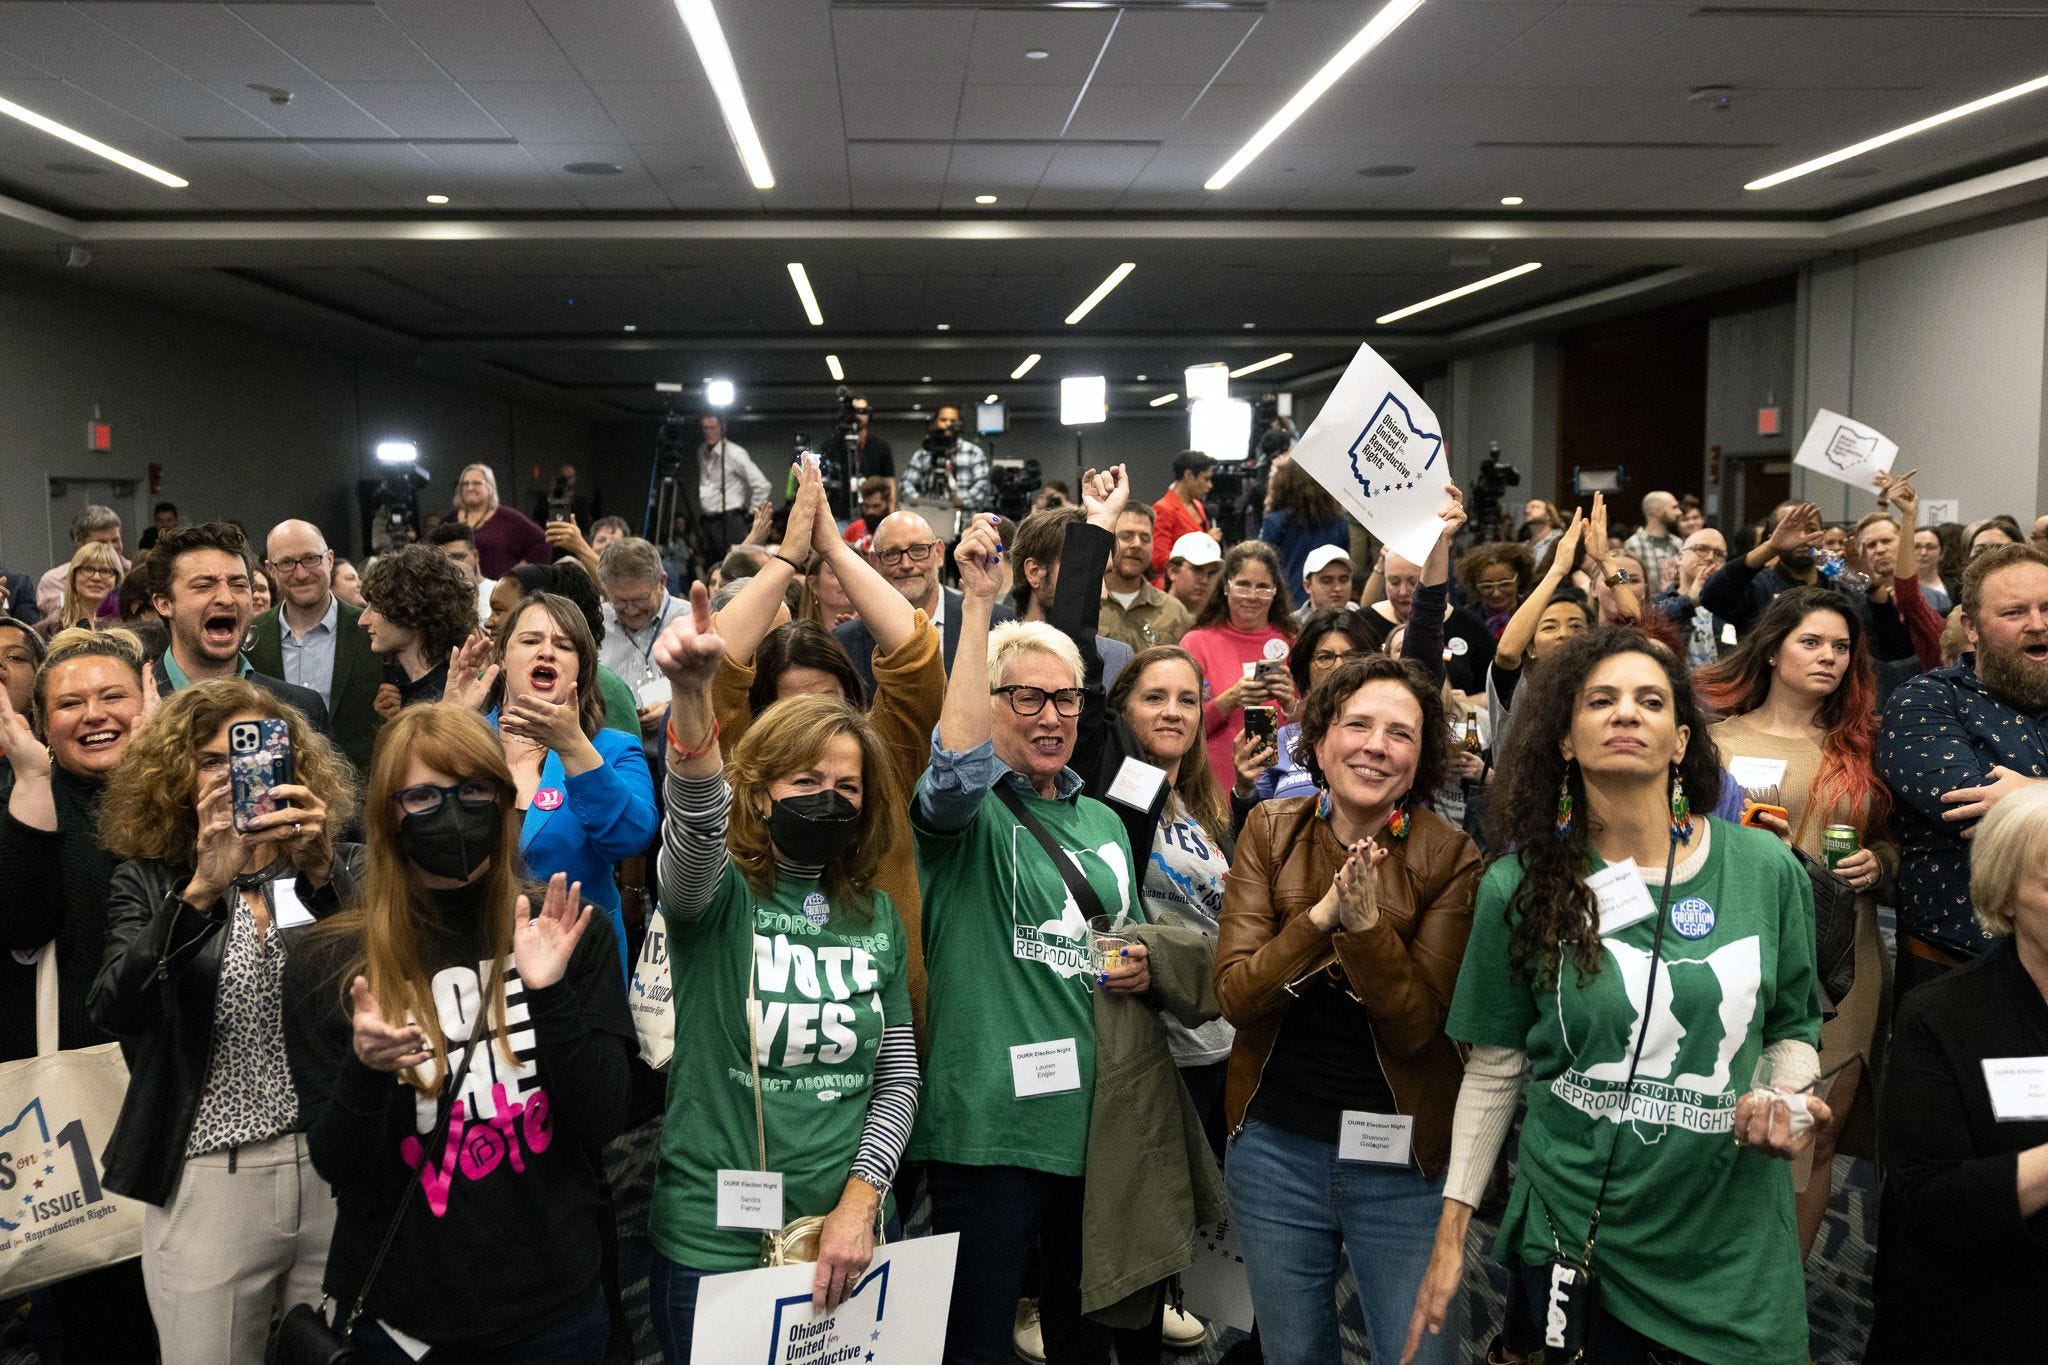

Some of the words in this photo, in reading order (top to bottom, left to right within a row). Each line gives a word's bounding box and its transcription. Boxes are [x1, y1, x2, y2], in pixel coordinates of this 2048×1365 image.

[1375, 424, 1399, 450] United
[1382, 414, 1409, 444] Ohioans
[1361, 444, 1385, 470] Rights
[1368, 434, 1411, 479] Reproductive
[1158, 815, 1210, 861] YES
[1615, 871, 1632, 881] Night
[1142, 887, 1165, 900] hioans
[1680, 899, 1706, 912] KEEP
[1674, 911, 1714, 924] ABORTION
[1677, 921, 1709, 936] LEGAL
[643, 930, 667, 965] YE
[755, 933, 878, 1001] VOTE
[402, 952, 532, 1044] OE
[746, 998, 858, 1068] YES
[1034, 1050, 1056, 1058] Election
[1056, 1046, 1071, 1054] Night
[728, 1066, 792, 1093] PROECT
[794, 1073, 864, 1096] ABORTION
[1035, 1063, 1056, 1071] Lauren
[1552, 1078, 1677, 1123] REPRODUCTIVE
[1562, 1071, 1591, 1088] HIO
[1604, 1080, 1703, 1107] PHYSICIANS
[1347, 1119, 1366, 1127] OURR
[1390, 1123, 1406, 1131] Night
[1361, 1133, 1390, 1141] Shannon
[400, 1082, 552, 1217] Vote
[1359, 1140, 1391, 1150] Gallagher
[16, 1152, 39, 1170] on
[56, 1118, 104, 1205] 1
[723, 1180, 741, 1188] OURR
[740, 1181, 762, 1189] Election
[762, 1183, 778, 1191] Night
[740, 1195, 761, 1204] Sandra
[31, 1189, 86, 1224] ISSUE
[24, 1212, 86, 1244] Reproductive
[86, 1203, 118, 1222] Rights
[789, 1317, 836, 1343] Ohioans
[786, 1334, 826, 1362] United
[826, 1332, 840, 1350] for
